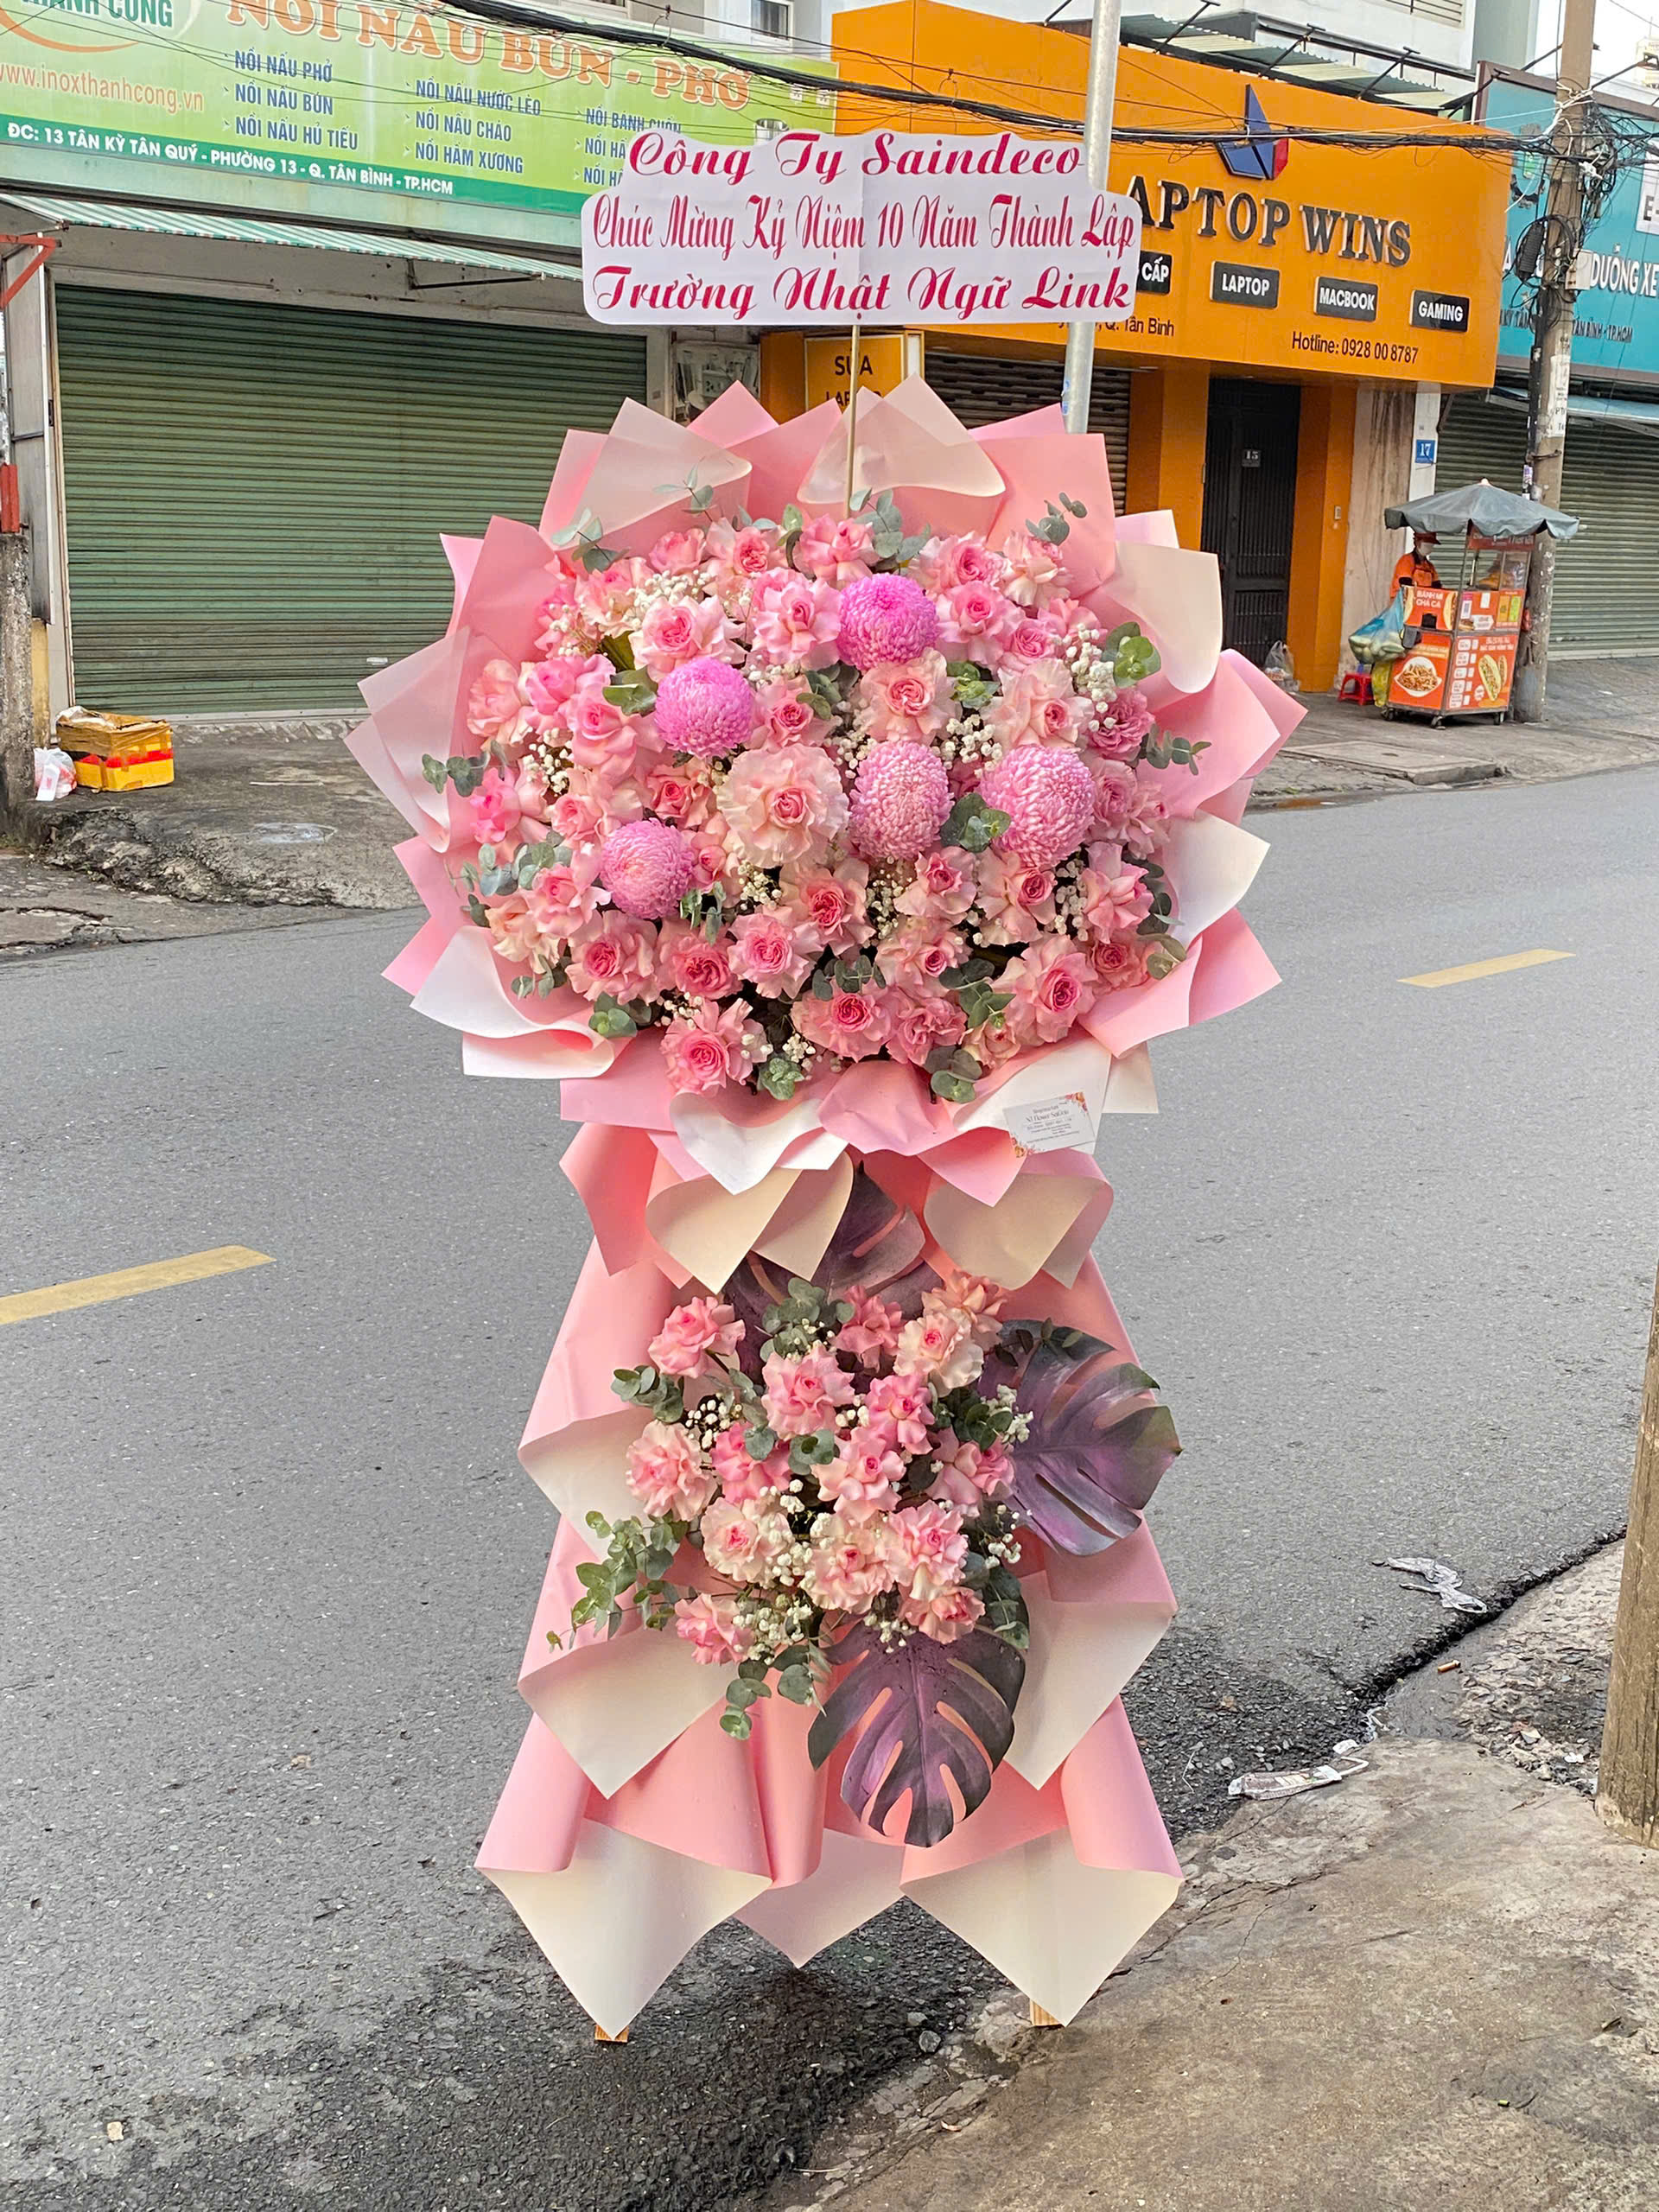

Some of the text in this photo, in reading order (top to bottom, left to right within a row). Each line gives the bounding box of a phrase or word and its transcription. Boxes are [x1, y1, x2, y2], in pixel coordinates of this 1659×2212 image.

[267, 52, 297, 78] NẤU
[303, 59, 333, 83] PHỞ
[303, 92, 334, 116] BÚN
[477, 88, 513, 112] NƯỚC
[267, 118, 297, 143] NẤU
[303, 122, 322, 146] HỦ
[327, 125, 359, 150] TIẾU
[477, 119, 512, 142] CHÁO
[8, 122, 39, 141] ĐC:
[44, 128, 64, 144] 13
[68, 127, 99, 149] TÂN
[105, 132, 125, 152] KỲ
[130, 137, 161, 157] TÂN
[164, 143, 199, 162] QUÝ
[211, 149, 276, 173] PHƯỜNG
[280, 159, 297, 175] 13
[308, 162, 325, 179] Q.
[328, 162, 356, 182] TÂN
[359, 166, 393, 188] BÌNH
[404, 175, 454, 195] TP.HCM
[479, 151, 524, 174] XƯƠNG
[629, 131, 1085, 186] Công Ty Saindeco
[593, 193, 1135, 261] Chúc Mừng Kỷ Niệm 10 Năm Thành Lập
[1127, 175, 1411, 267] APTOP WINS
[1141, 256, 1170, 283] CẤP
[1640, 262, 1658, 297] XE
[593, 265, 1132, 321] Trường Nhật Ngữ Link
[1222, 273, 1269, 297] LAPTOP
[1319, 286, 1376, 311] MACBOOK
[1418, 300, 1464, 323] GAMING
[1124, 316, 1144, 333] Tân
[1147, 317, 1174, 337] Bình
[1292, 331, 1419, 364] Hotline: 0928 00 8787
[1420, 442, 1432, 456] 17
